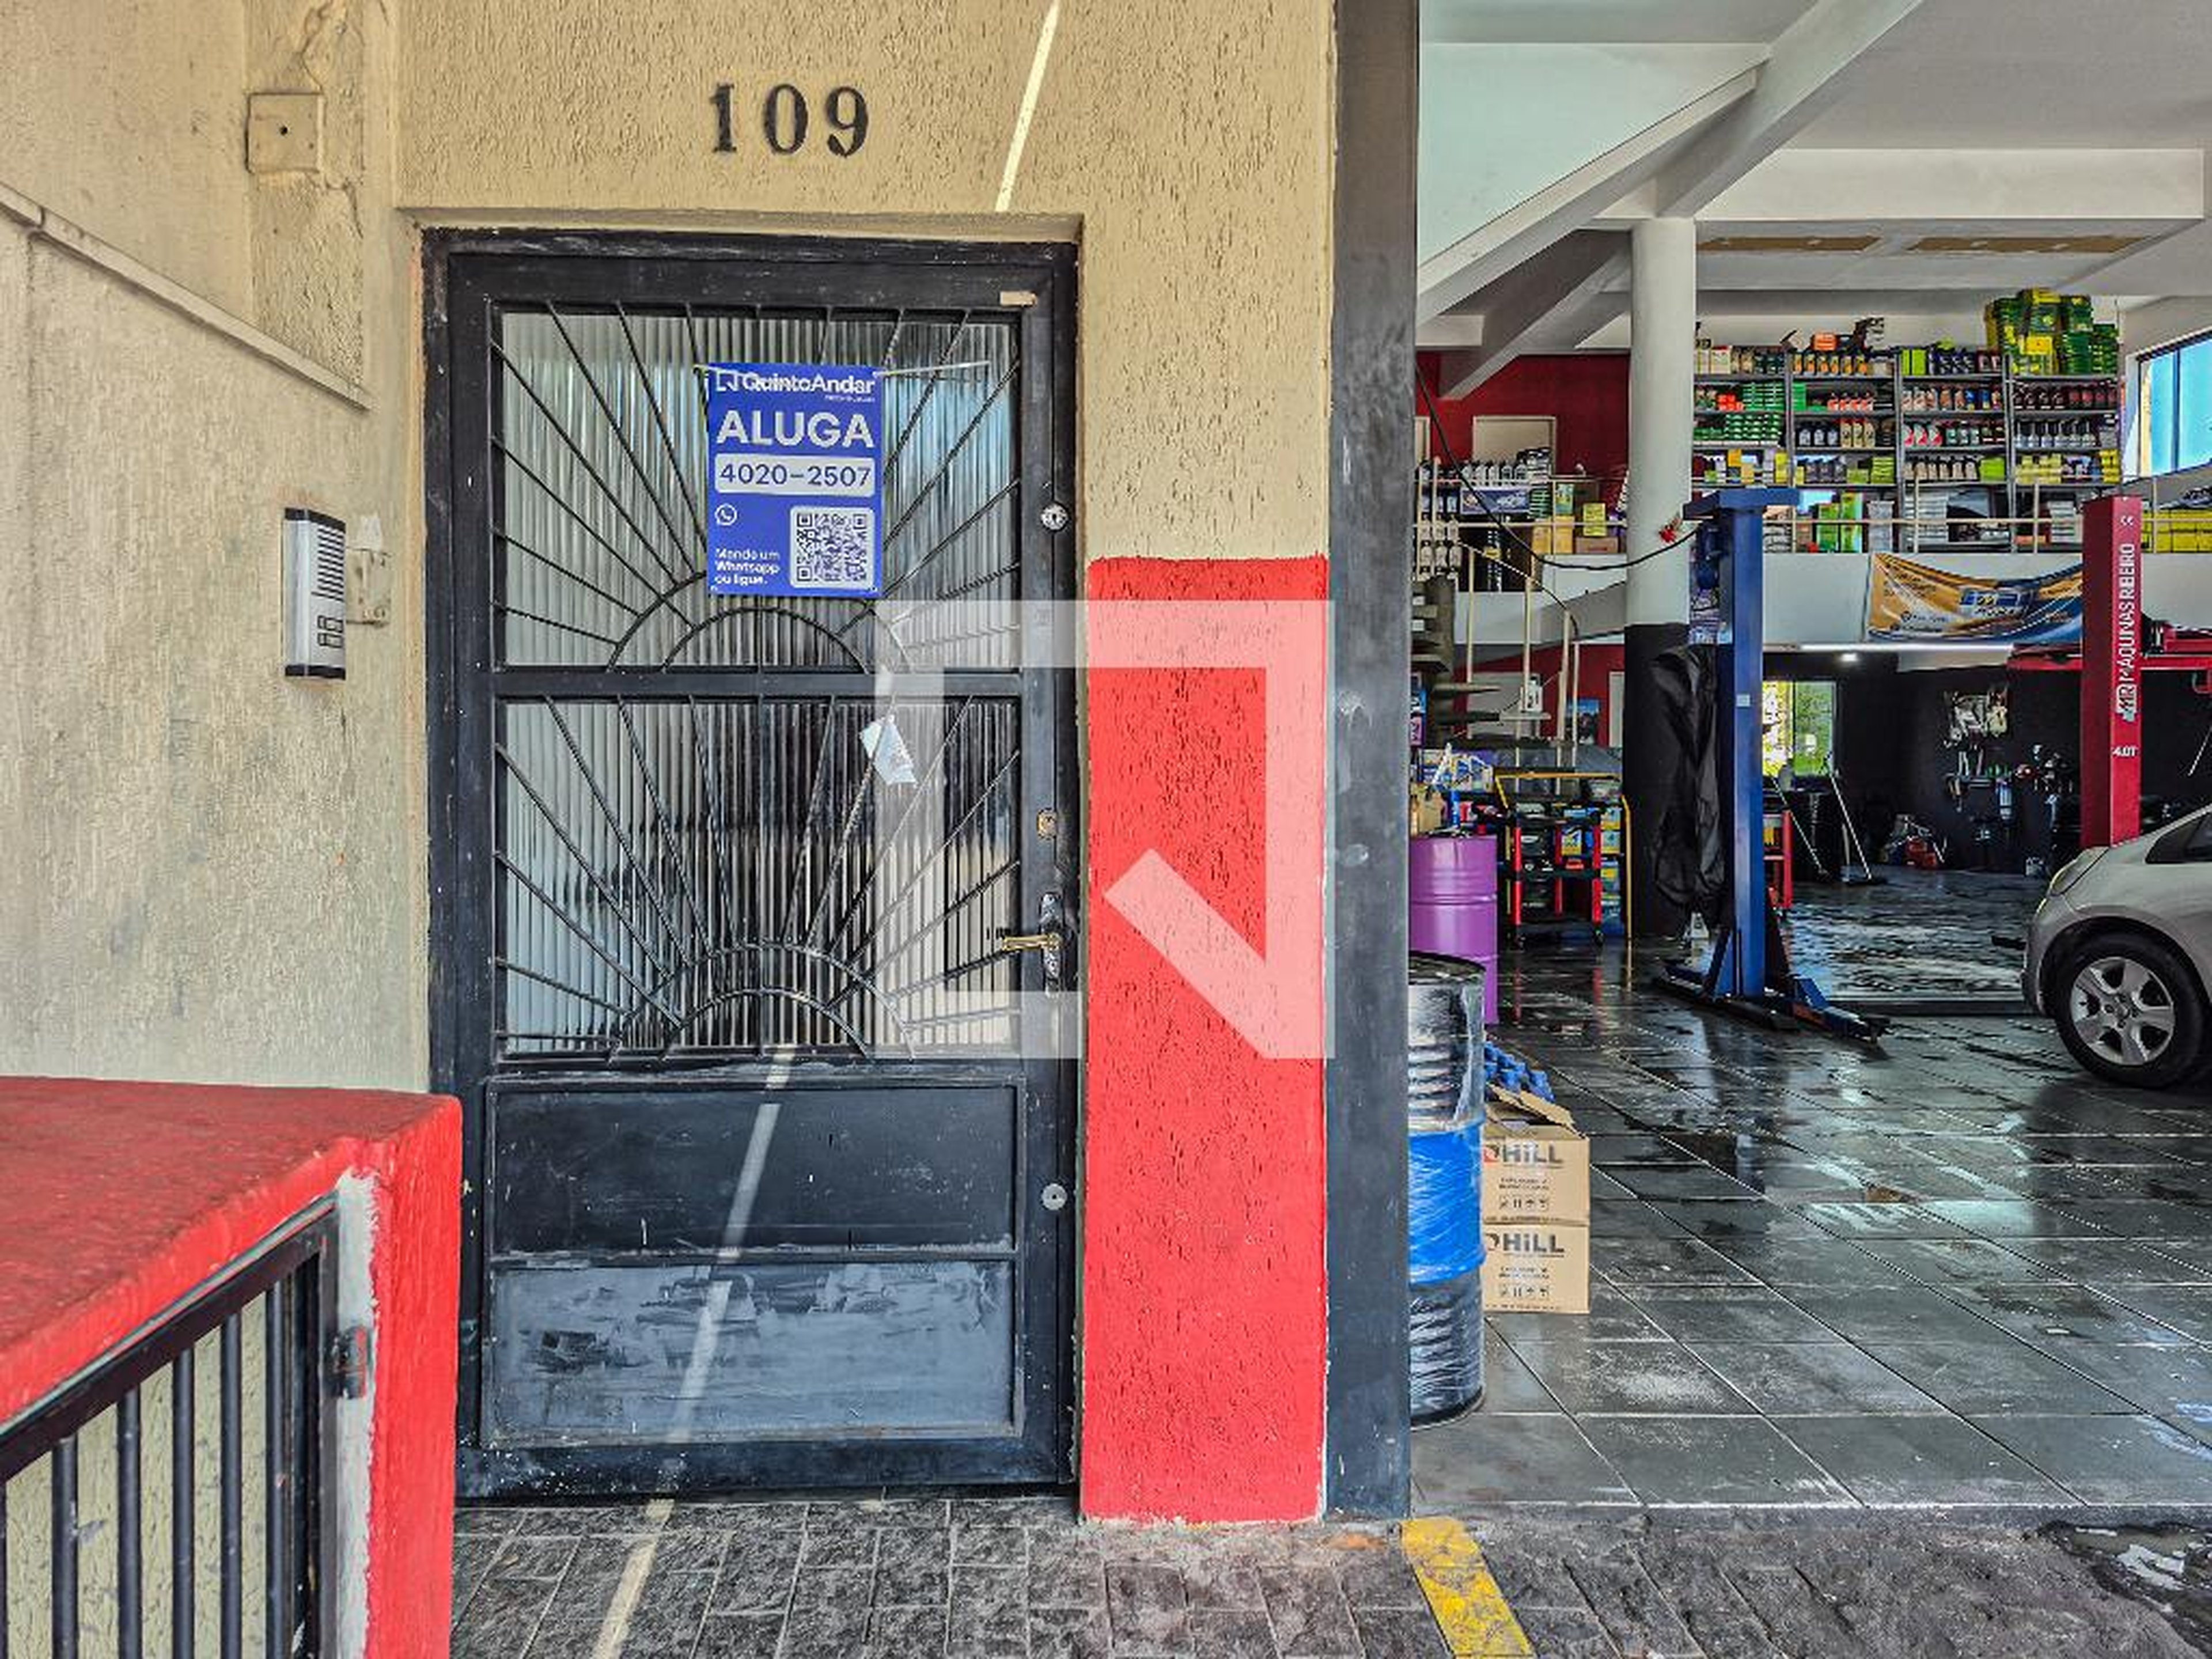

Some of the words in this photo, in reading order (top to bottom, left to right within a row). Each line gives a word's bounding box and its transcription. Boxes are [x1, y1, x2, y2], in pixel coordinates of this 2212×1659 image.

[710, 84, 869, 157] 109
[742, 373, 876, 394] QuintoAndar
[717, 410, 874, 448] ALUGA
[719, 464, 871, 487] 4020-2507
[2118, 543, 2135, 600] RIBEIRO
